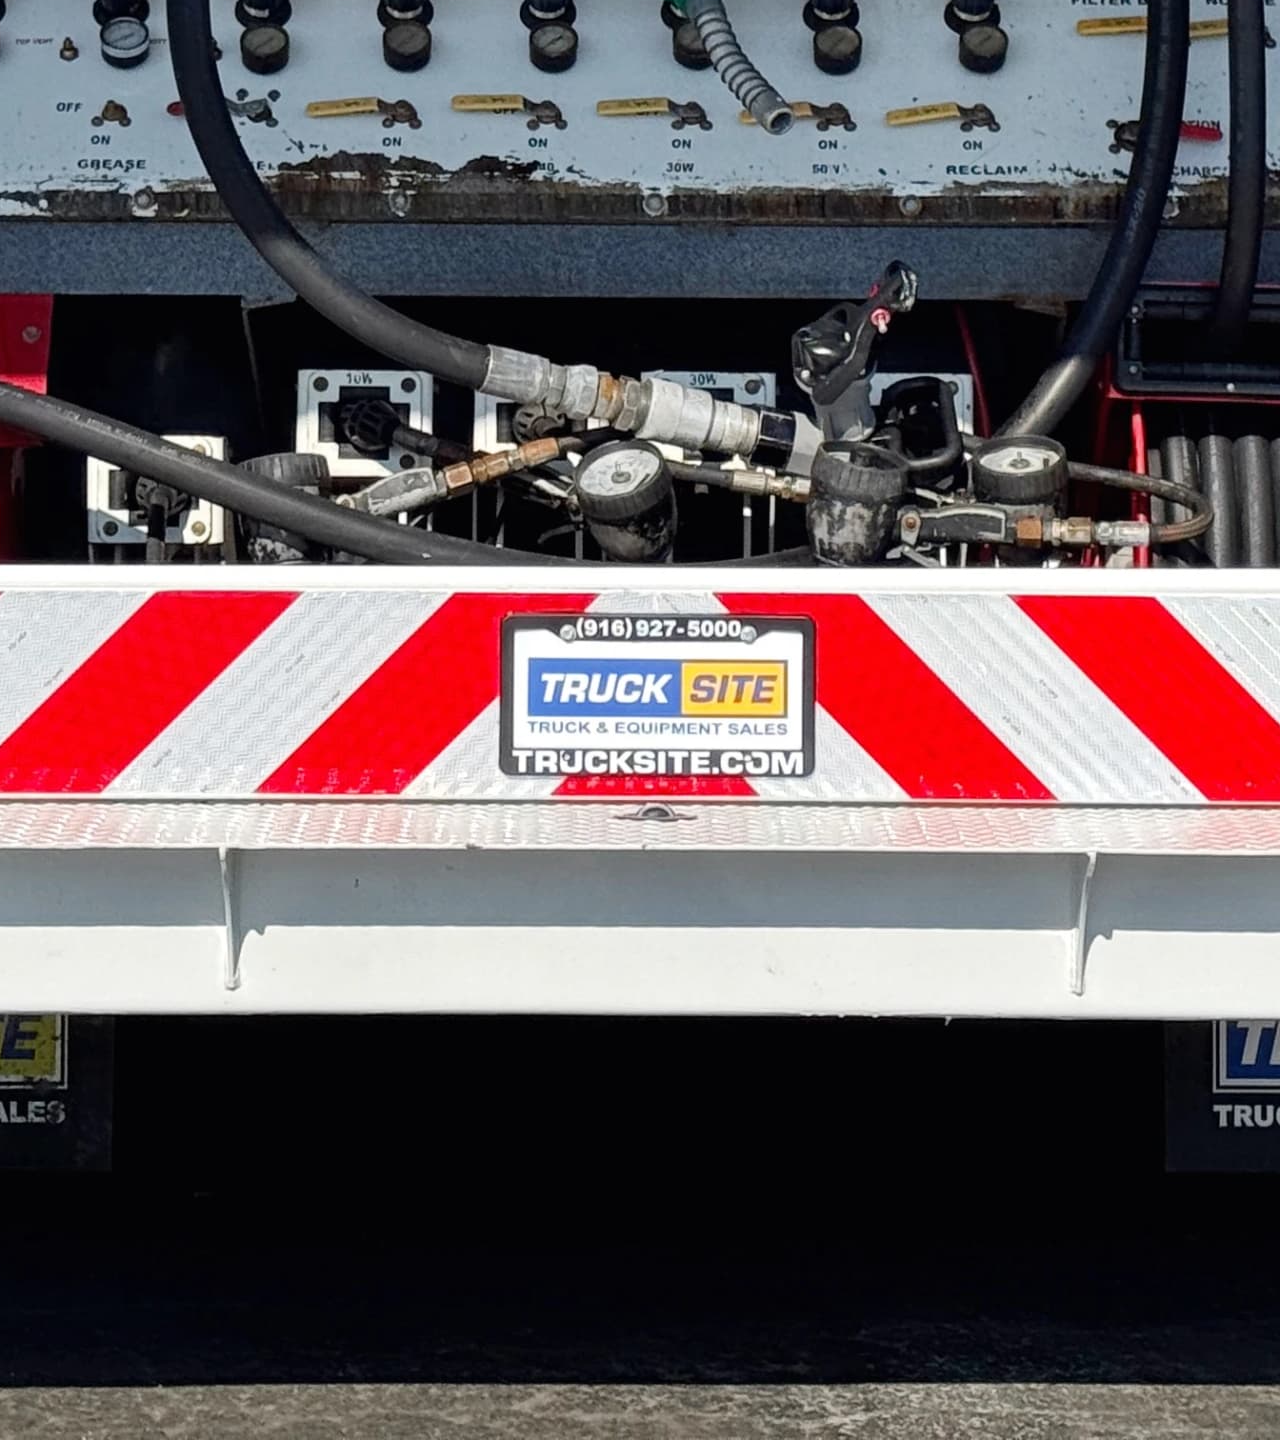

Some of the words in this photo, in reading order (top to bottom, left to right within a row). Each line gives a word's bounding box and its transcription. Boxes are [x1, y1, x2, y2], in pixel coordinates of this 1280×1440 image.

[56, 102, 83, 112] OFF
[90, 135, 111, 145] ON
[382, 137, 402, 147] ON
[528, 138, 548, 148] ON
[672, 139, 692, 149] ON
[818, 140, 838, 150] ON
[962, 140, 983, 150] ON
[77, 159, 147, 170] GREASE
[665, 162, 694, 173] 30W
[946, 164, 1028, 176] RECLAIM
[576, 618, 633, 640] (916)
[636, 620, 741, 639] 927-5000
[541, 673, 672, 704] TRUCK
[690, 675, 778, 704] SITE
[528, 720, 590, 734] TRUCK
[596, 721, 608, 735] &
[615, 722, 722, 736] EQUIPMENT
[728, 723, 788, 736] SALES
[512, 749, 804, 775] TRUCKSITE.COM
